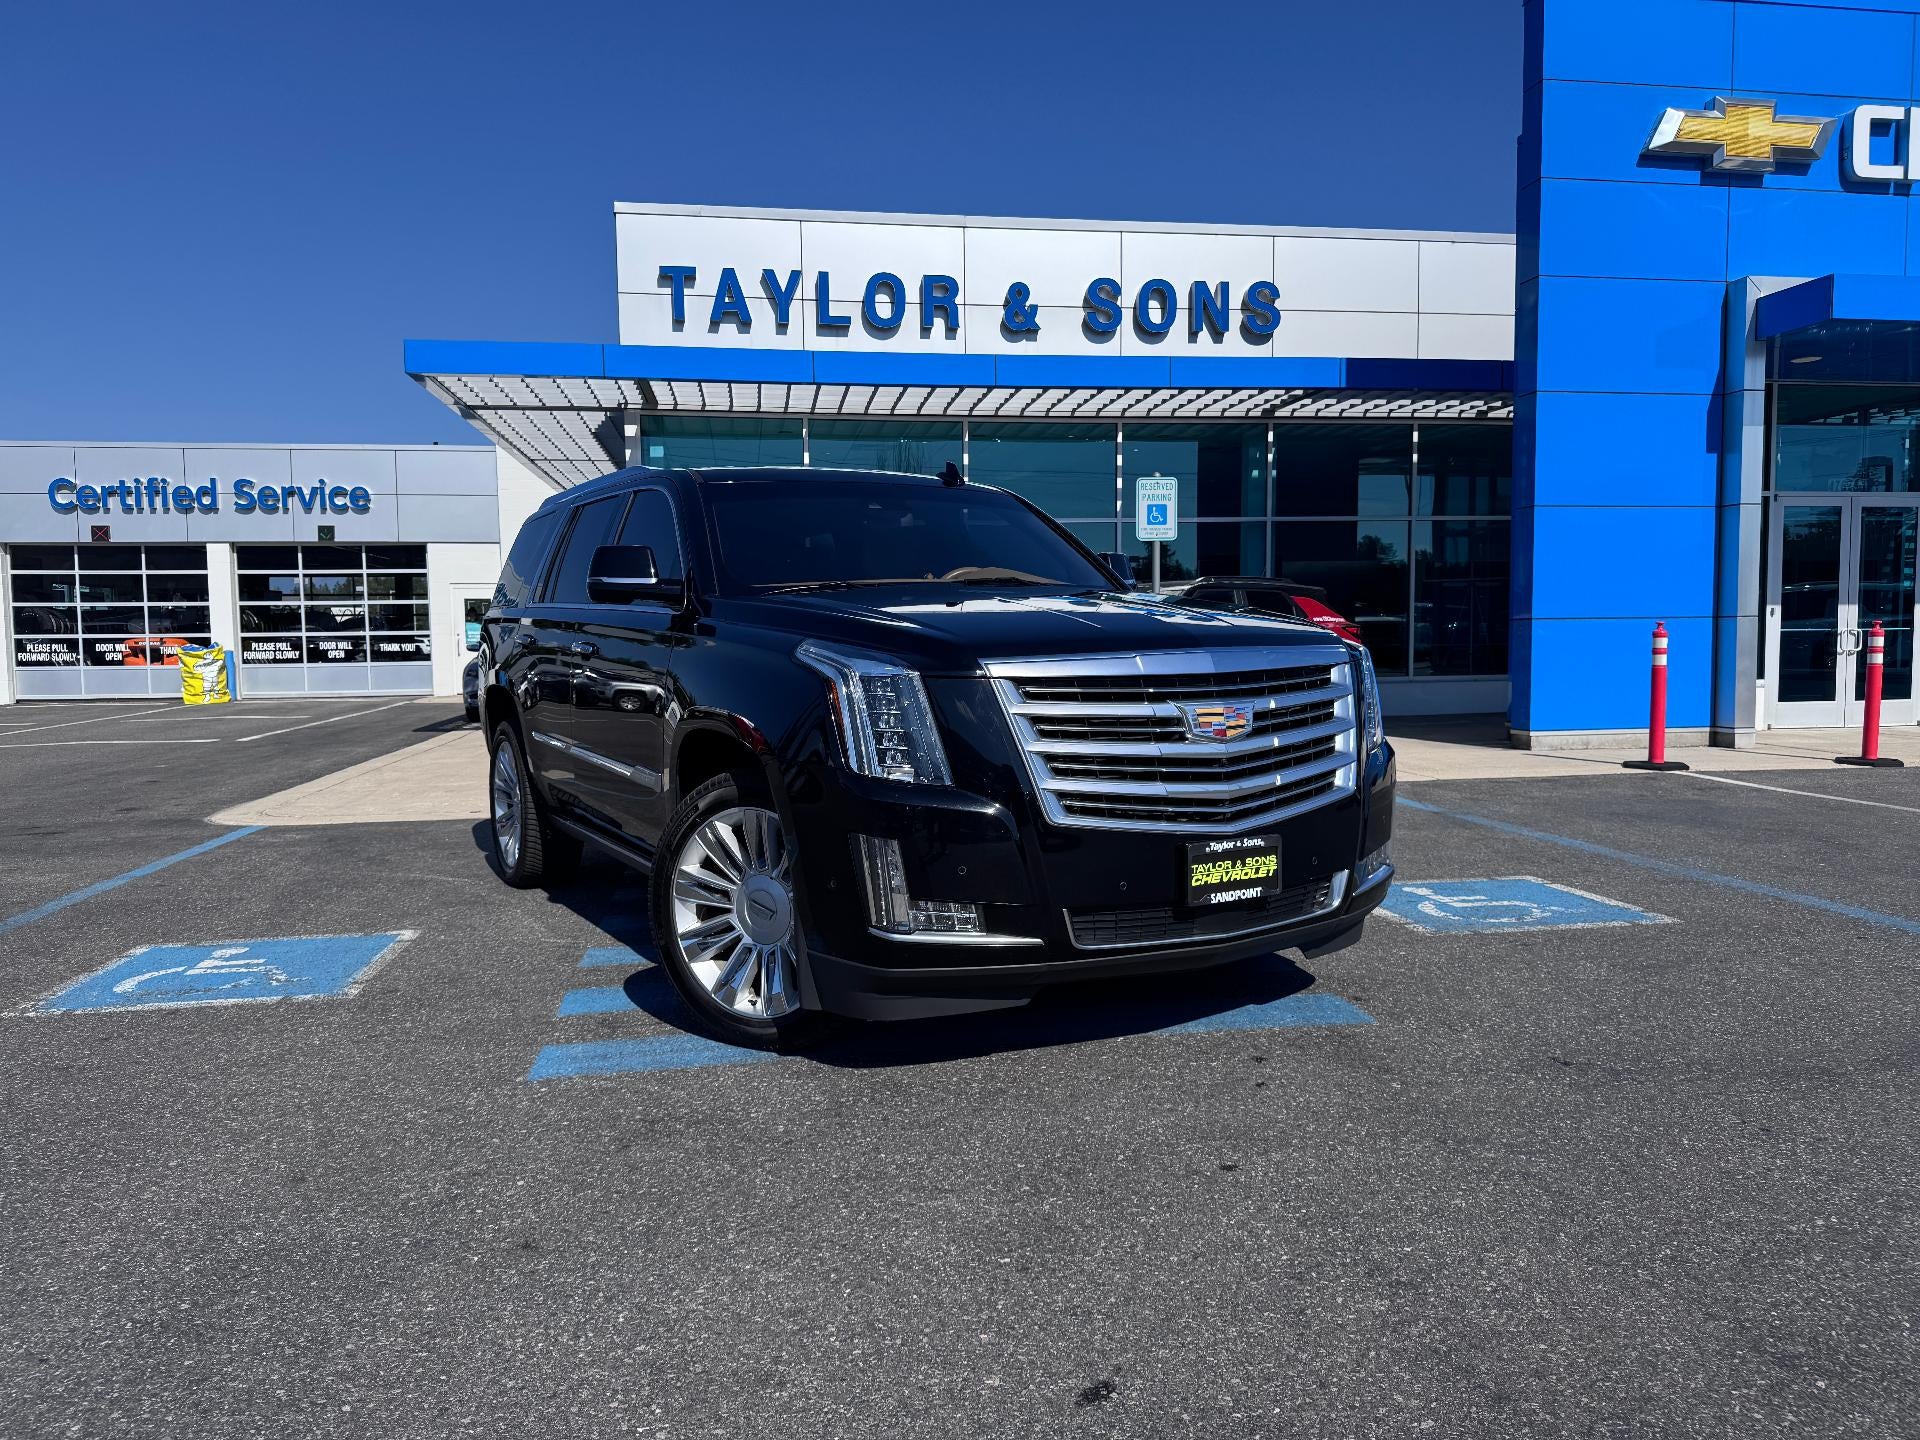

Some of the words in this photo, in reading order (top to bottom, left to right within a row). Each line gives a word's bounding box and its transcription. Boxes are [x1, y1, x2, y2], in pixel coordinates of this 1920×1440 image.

[1852, 104, 1920, 180] C
[657, 266, 960, 329] TAYLOR
[1001, 281, 1041, 331] &
[1084, 277, 1281, 334] SONS
[1140, 482, 1174, 491] RESERVED
[48, 477, 217, 510] Certified
[233, 478, 370, 510] Service
[1142, 493, 1172, 502] PARKING
[26, 643, 51, 652] PLEASE
[51, 643, 69, 652] PULL
[95, 643, 114, 652] DOOR
[114, 643, 131, 652] WILL
[251, 642, 276, 651] PLEASE
[275, 642, 292, 651] PULL
[319, 641, 337, 650] DOOR
[337, 641, 353, 650] WILL
[380, 643, 401, 652] THANK
[160, 646, 178, 655] THAN
[243, 651, 275, 660] FORWARD
[275, 650, 300, 660] SLOWLY
[327, 650, 345, 659] OPEN
[18, 652, 50, 662] FORWARD
[51, 652, 77, 662] SLOWLY
[105, 652, 123, 661] OPEN
[1209, 840, 1236, 853] Taylor
[1242, 838, 1262, 847] Sons
[1191, 860, 1232, 875] TAYLOR
[1235, 859, 1243, 870] &
[1245, 854, 1277, 868] SONS
[1191, 865, 1278, 887] CHEVROLET
[1210, 886, 1263, 904] SANDPOINT
